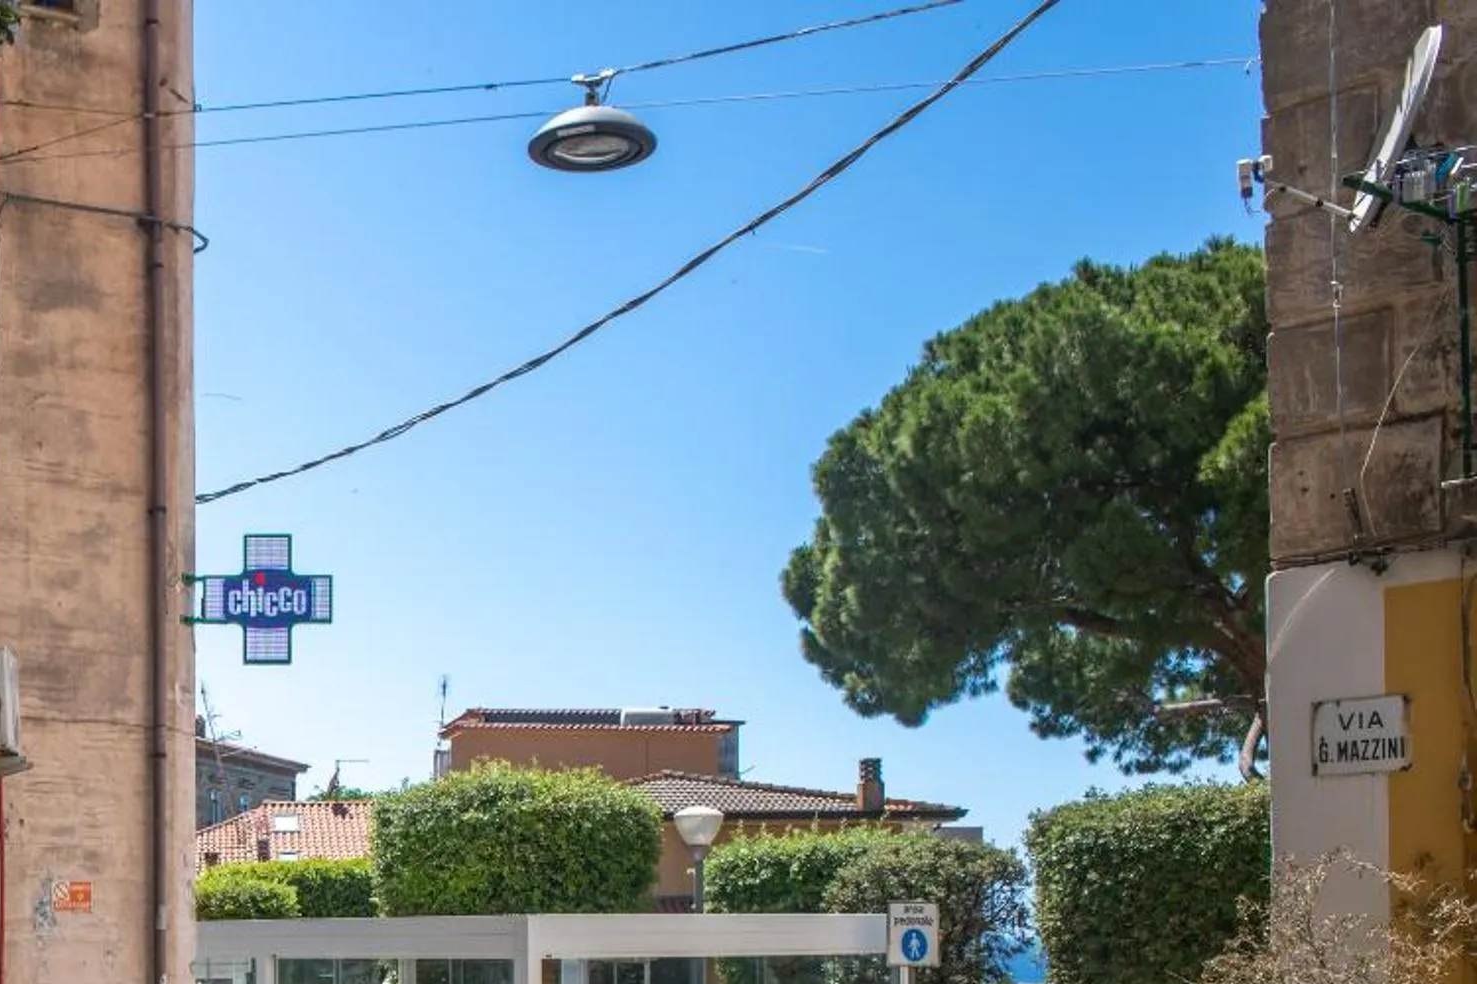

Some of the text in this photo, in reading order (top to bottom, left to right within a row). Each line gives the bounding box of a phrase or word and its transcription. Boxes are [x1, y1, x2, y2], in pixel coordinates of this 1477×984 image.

[228, 572, 307, 617] chicco
[1338, 711, 1384, 730] VIA
[1318, 736, 1406, 763] G. MAZZINI
